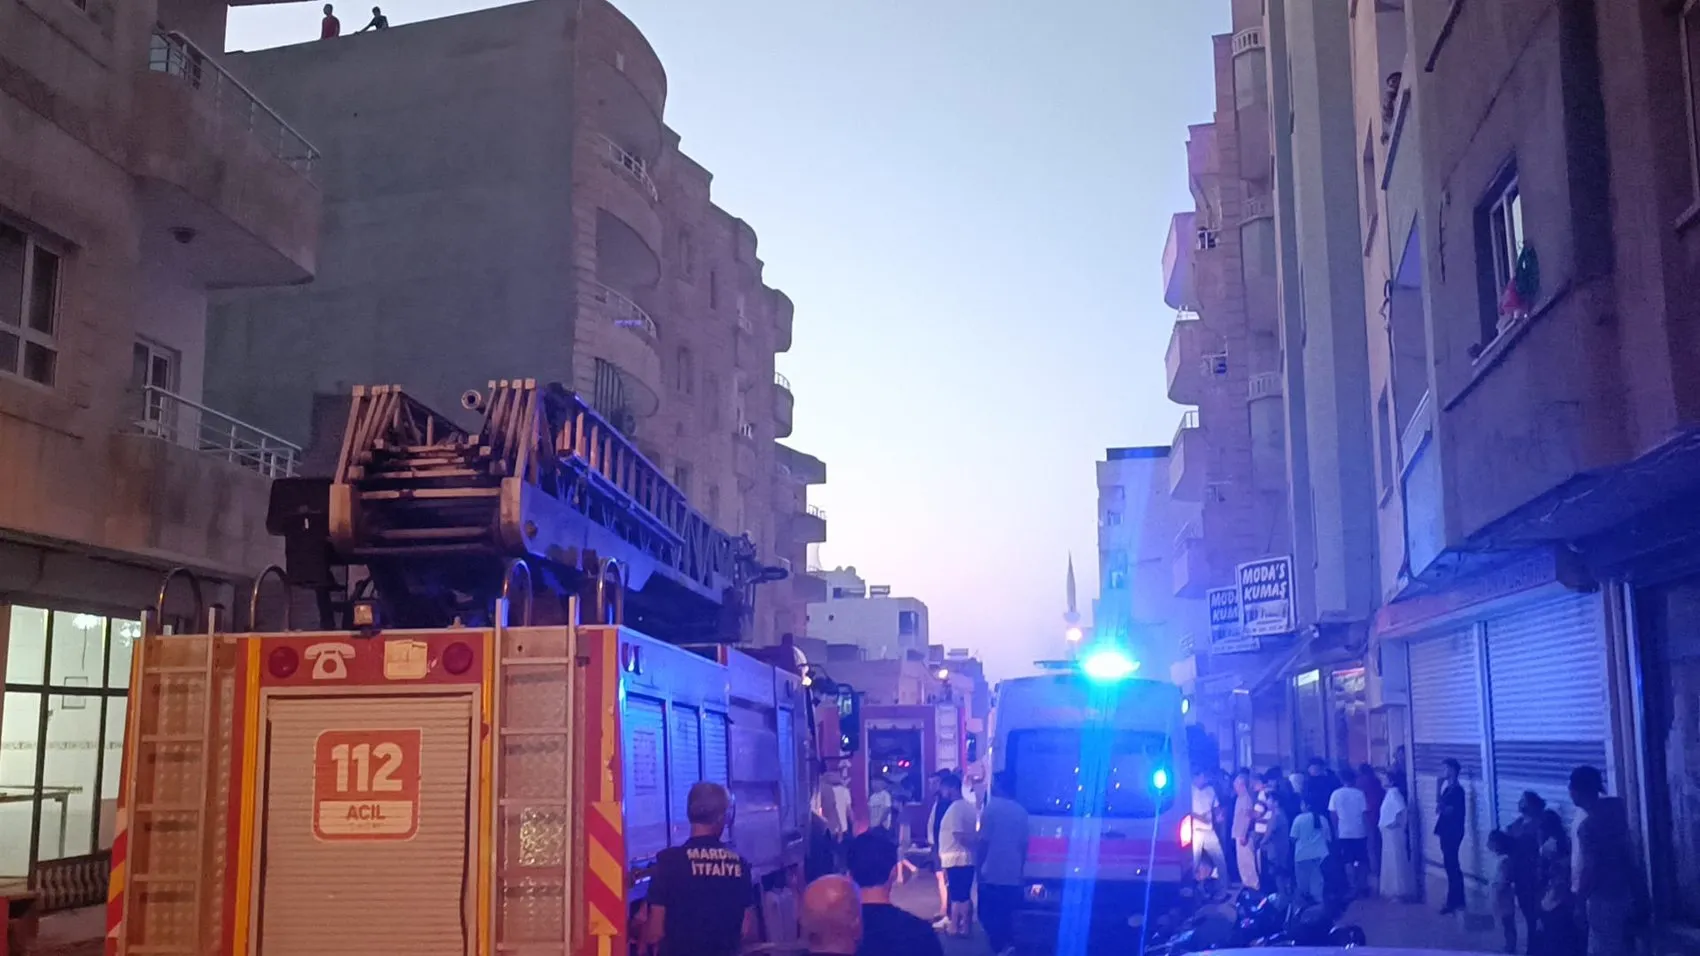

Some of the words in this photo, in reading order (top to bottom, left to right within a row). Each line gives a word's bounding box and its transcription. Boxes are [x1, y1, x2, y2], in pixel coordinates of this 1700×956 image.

[1243, 563, 1286, 584] MODA'S
[1211, 591, 1238, 607] MOD
[1212, 606, 1239, 623] KUM
[332, 742, 403, 792] 112
